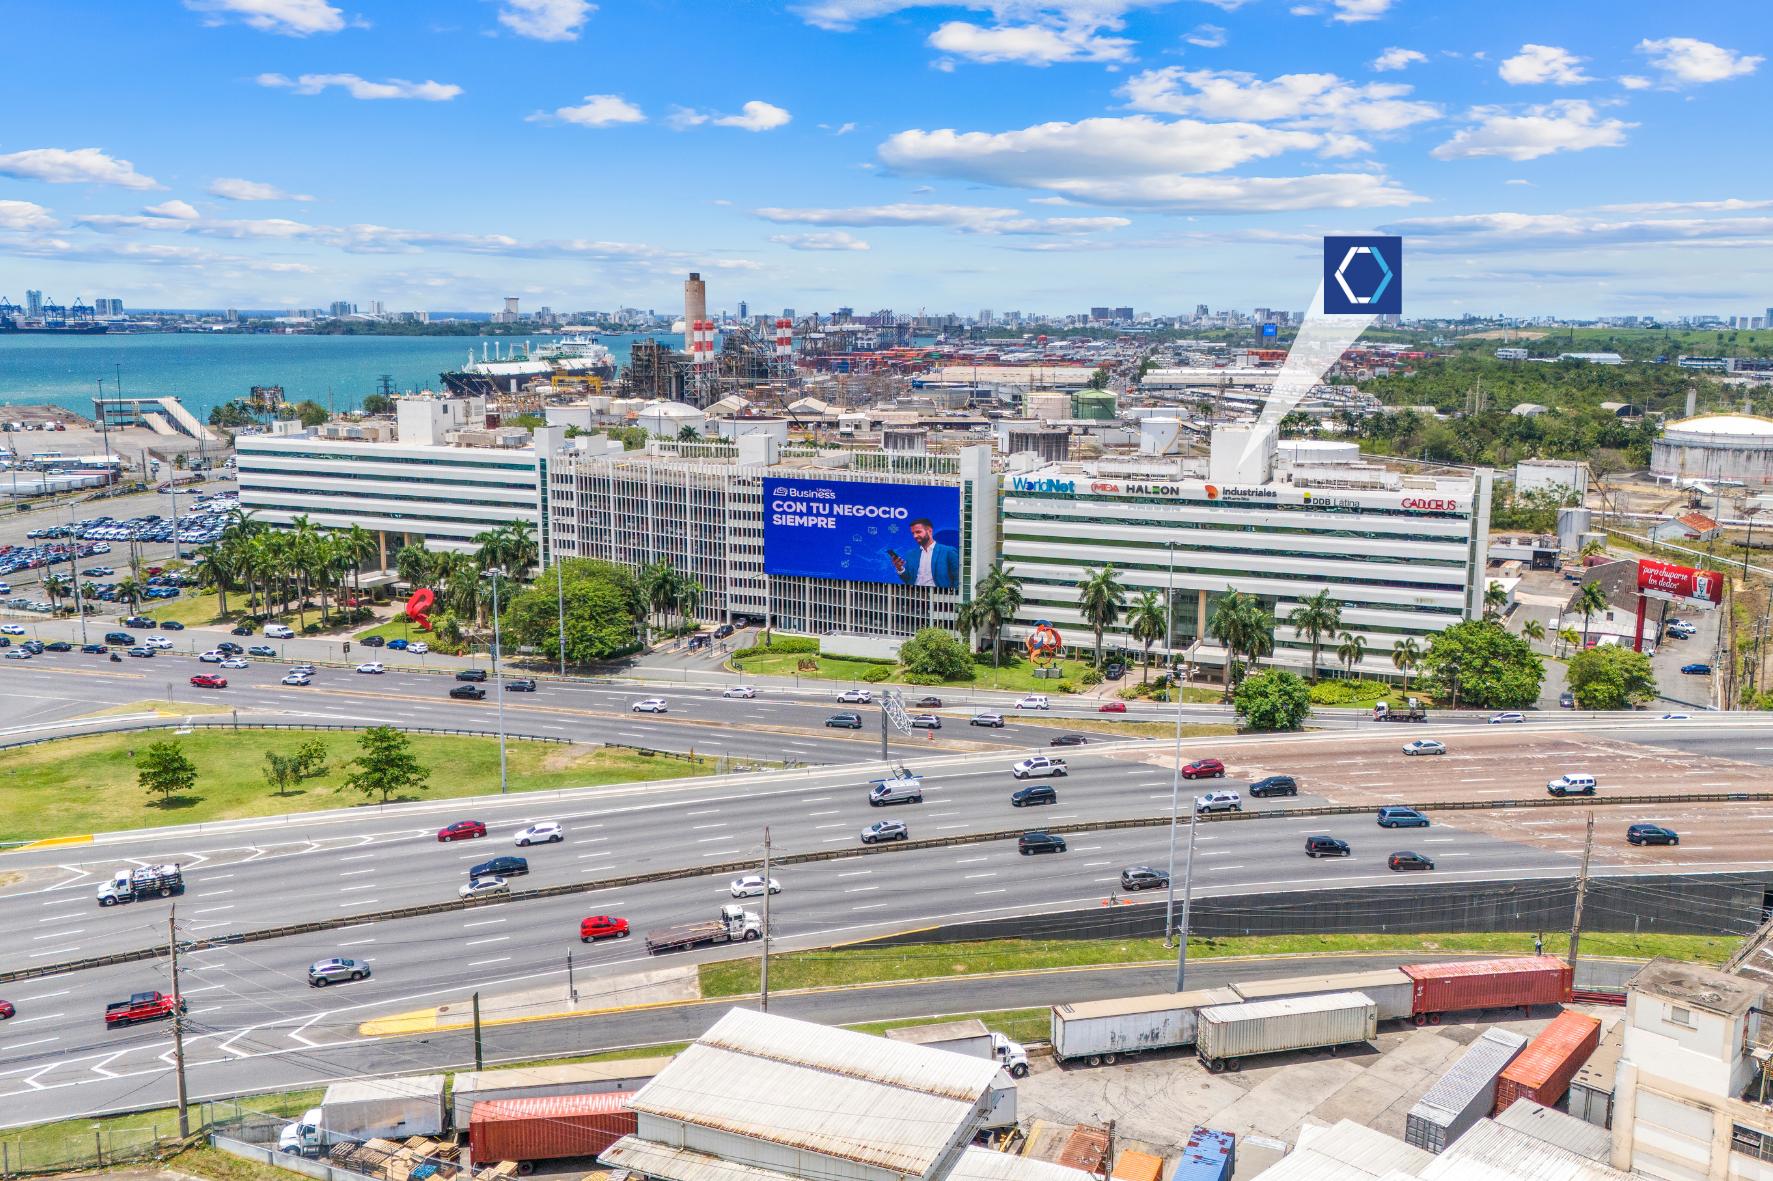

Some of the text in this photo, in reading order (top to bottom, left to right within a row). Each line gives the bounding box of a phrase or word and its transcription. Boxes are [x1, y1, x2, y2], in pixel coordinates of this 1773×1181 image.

[1012, 477, 1075, 493] WorldNet
[1126, 484, 1179, 496] HALEON
[789, 488, 836, 499] Business
[1222, 486, 1277, 497] Industriales
[1312, 497, 1360, 507] DDB Latina
[1401, 498, 1456, 511] CADUCEUS
[772, 500, 908, 519] CON TU NEGOCIO
[772, 514, 836, 529] SIEMPRE
